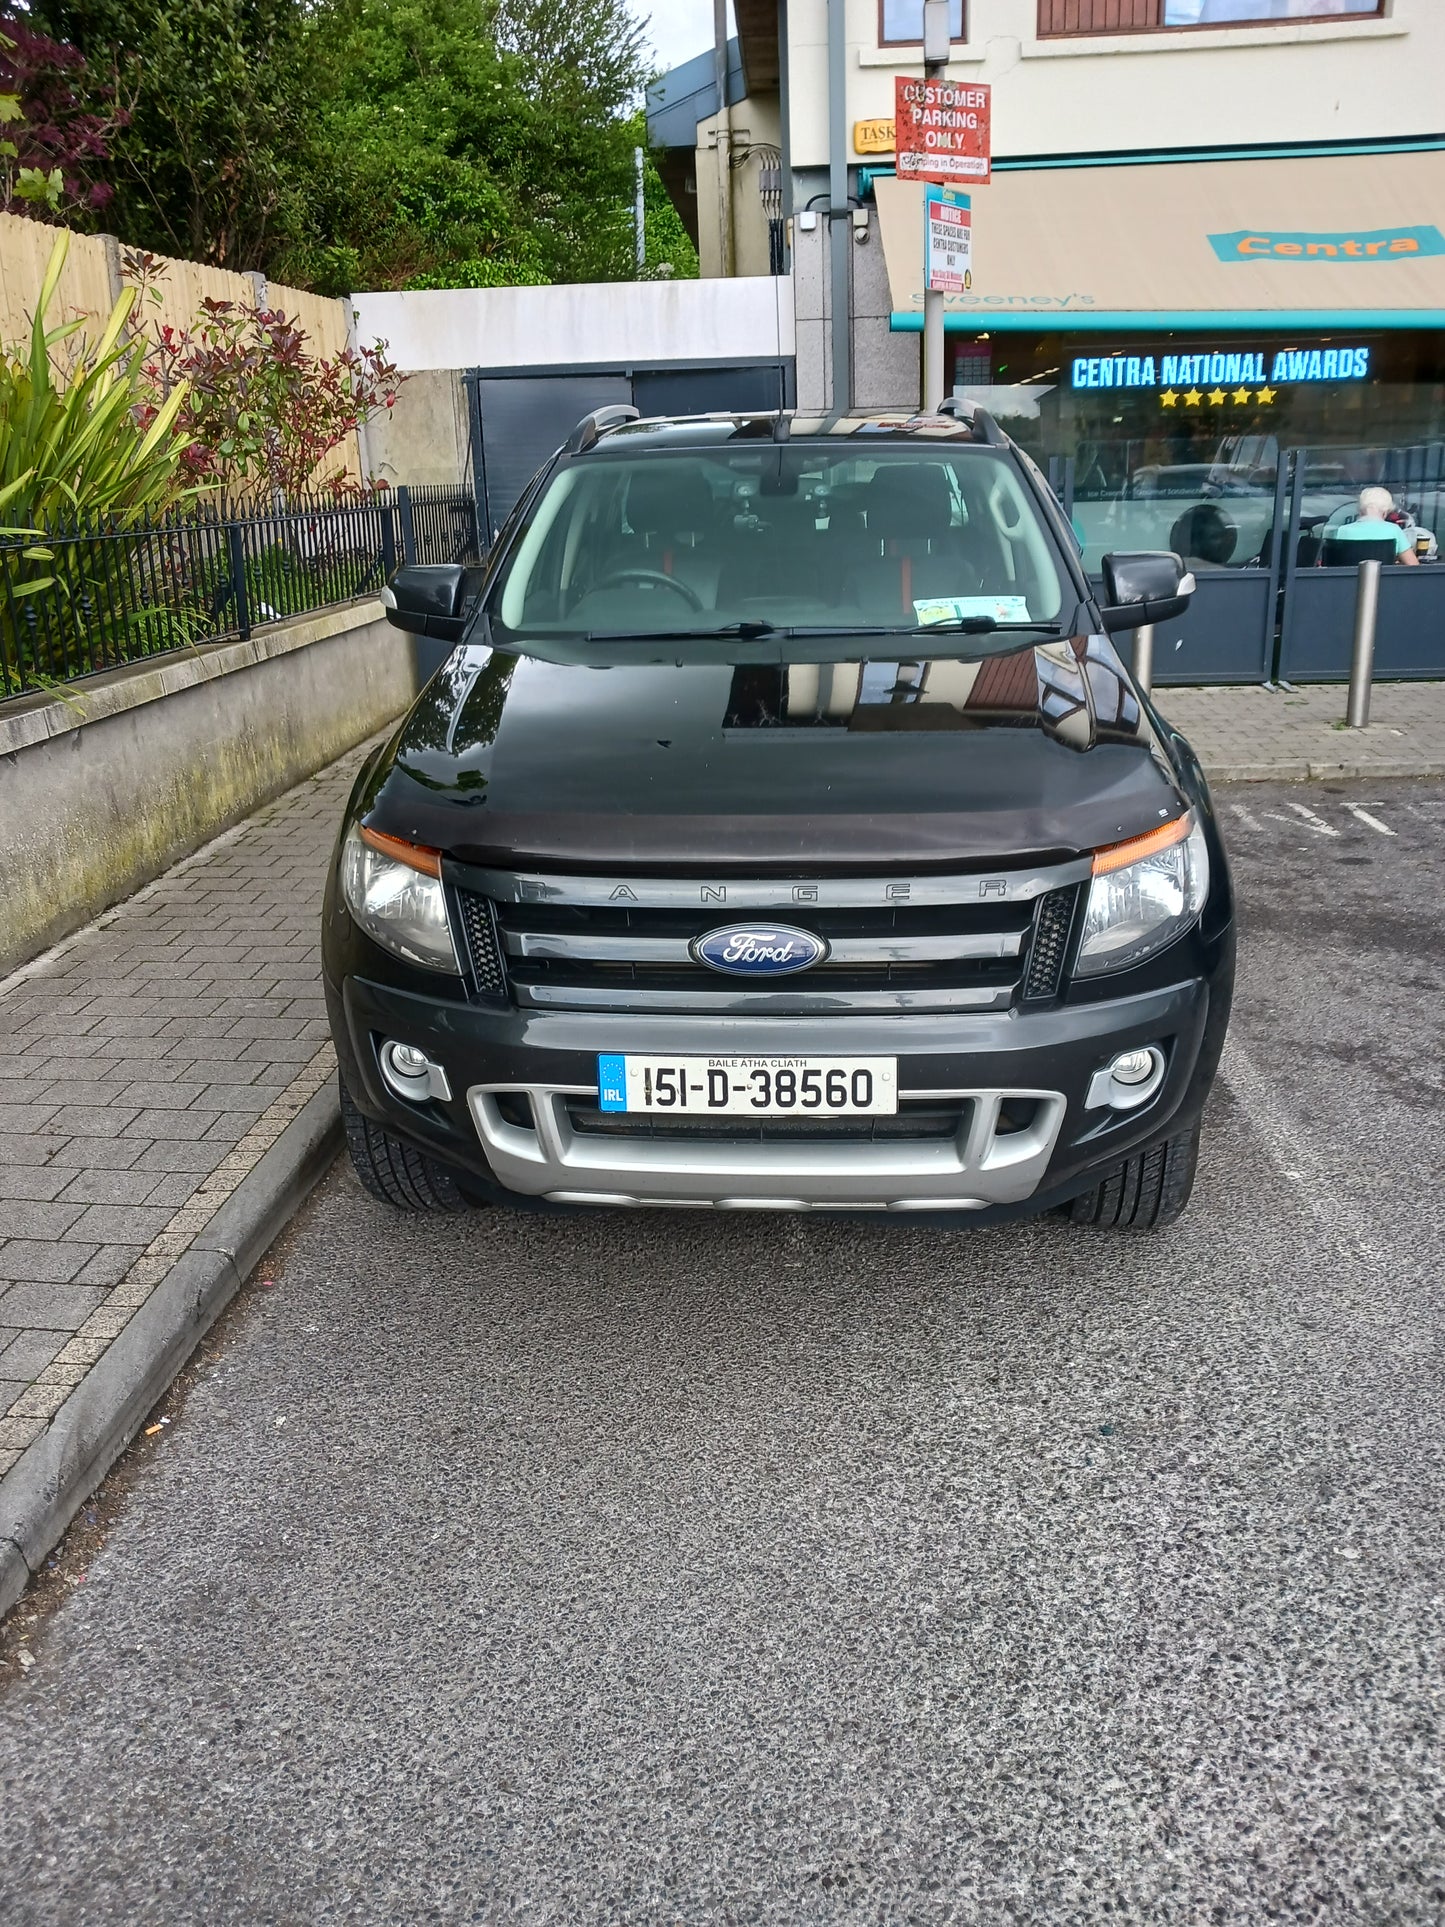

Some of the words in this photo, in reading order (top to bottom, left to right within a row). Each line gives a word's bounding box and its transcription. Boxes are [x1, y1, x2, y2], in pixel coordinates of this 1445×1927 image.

[904, 84, 986, 109] CUSTOMER
[912, 108, 978, 129] PARKING
[925, 130, 965, 149] ONLY
[940, 157, 948, 167] in
[949, 156, 985, 170] Operation
[940, 205, 962, 224] NOTICE
[1237, 237, 1419, 256] Centra
[1073, 356, 1156, 387] CENTRA
[1161, 353, 1267, 385] NATIONAL
[1272, 348, 1369, 382] AWARDS
[519, 879, 1008, 902] RANGER
[722, 933, 794, 963] Ford
[708, 1059, 738, 1068] BAILE
[770, 1059, 808, 1068] CLIATH
[603, 1089, 624, 1102] IRL
[644, 1068, 873, 1108] 151-D-38560
